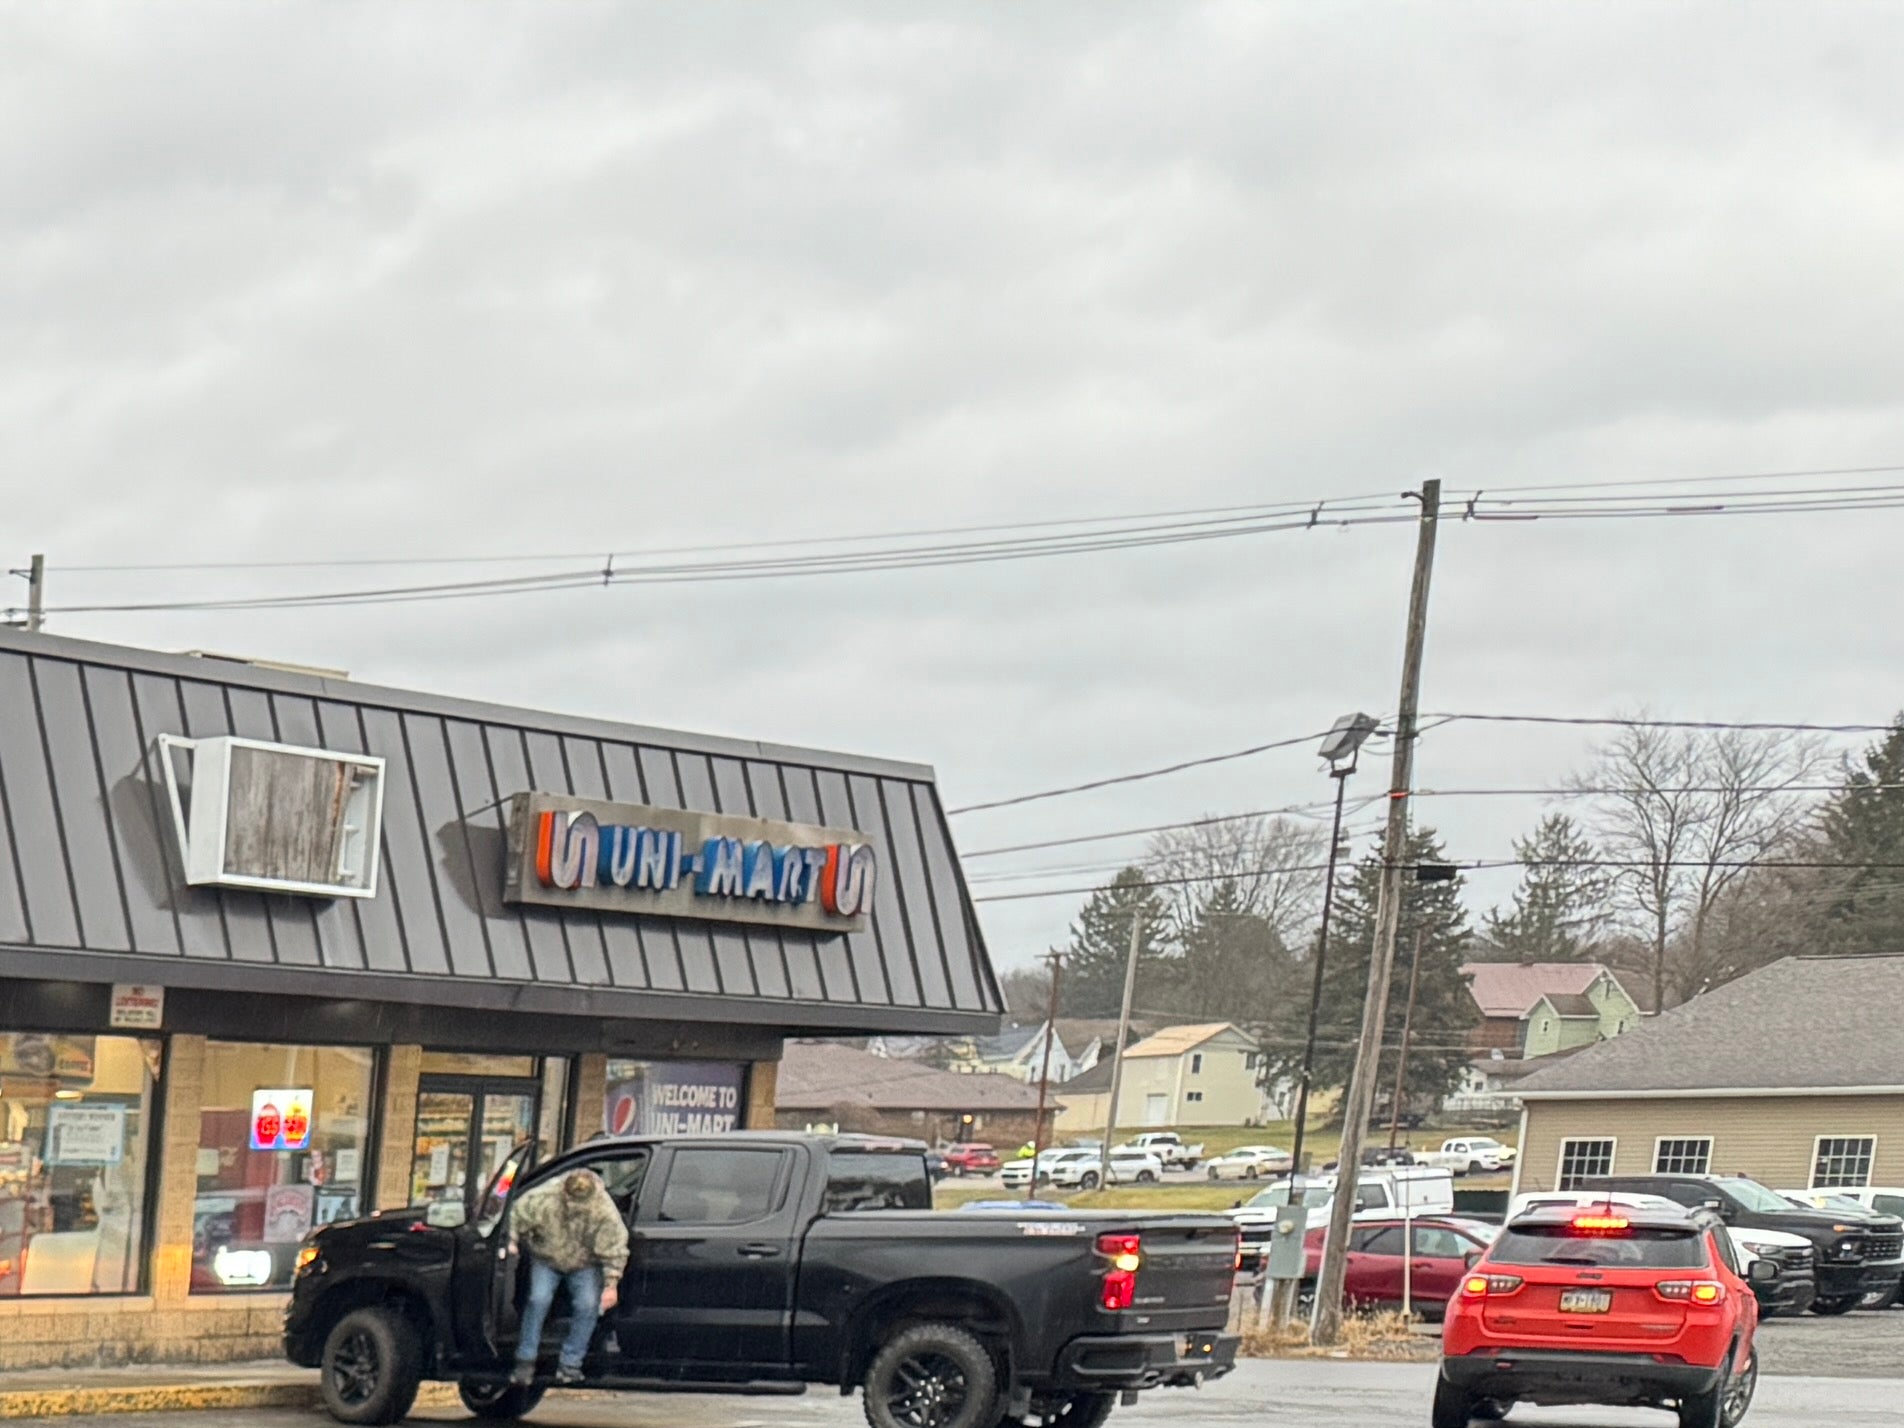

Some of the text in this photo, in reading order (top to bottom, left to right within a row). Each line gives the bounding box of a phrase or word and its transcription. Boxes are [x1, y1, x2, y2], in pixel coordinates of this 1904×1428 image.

[598, 823, 828, 905] UNI-MART
[653, 1084, 738, 1109] WELCOME TO
[649, 1112, 736, 1136] UNI-MART
